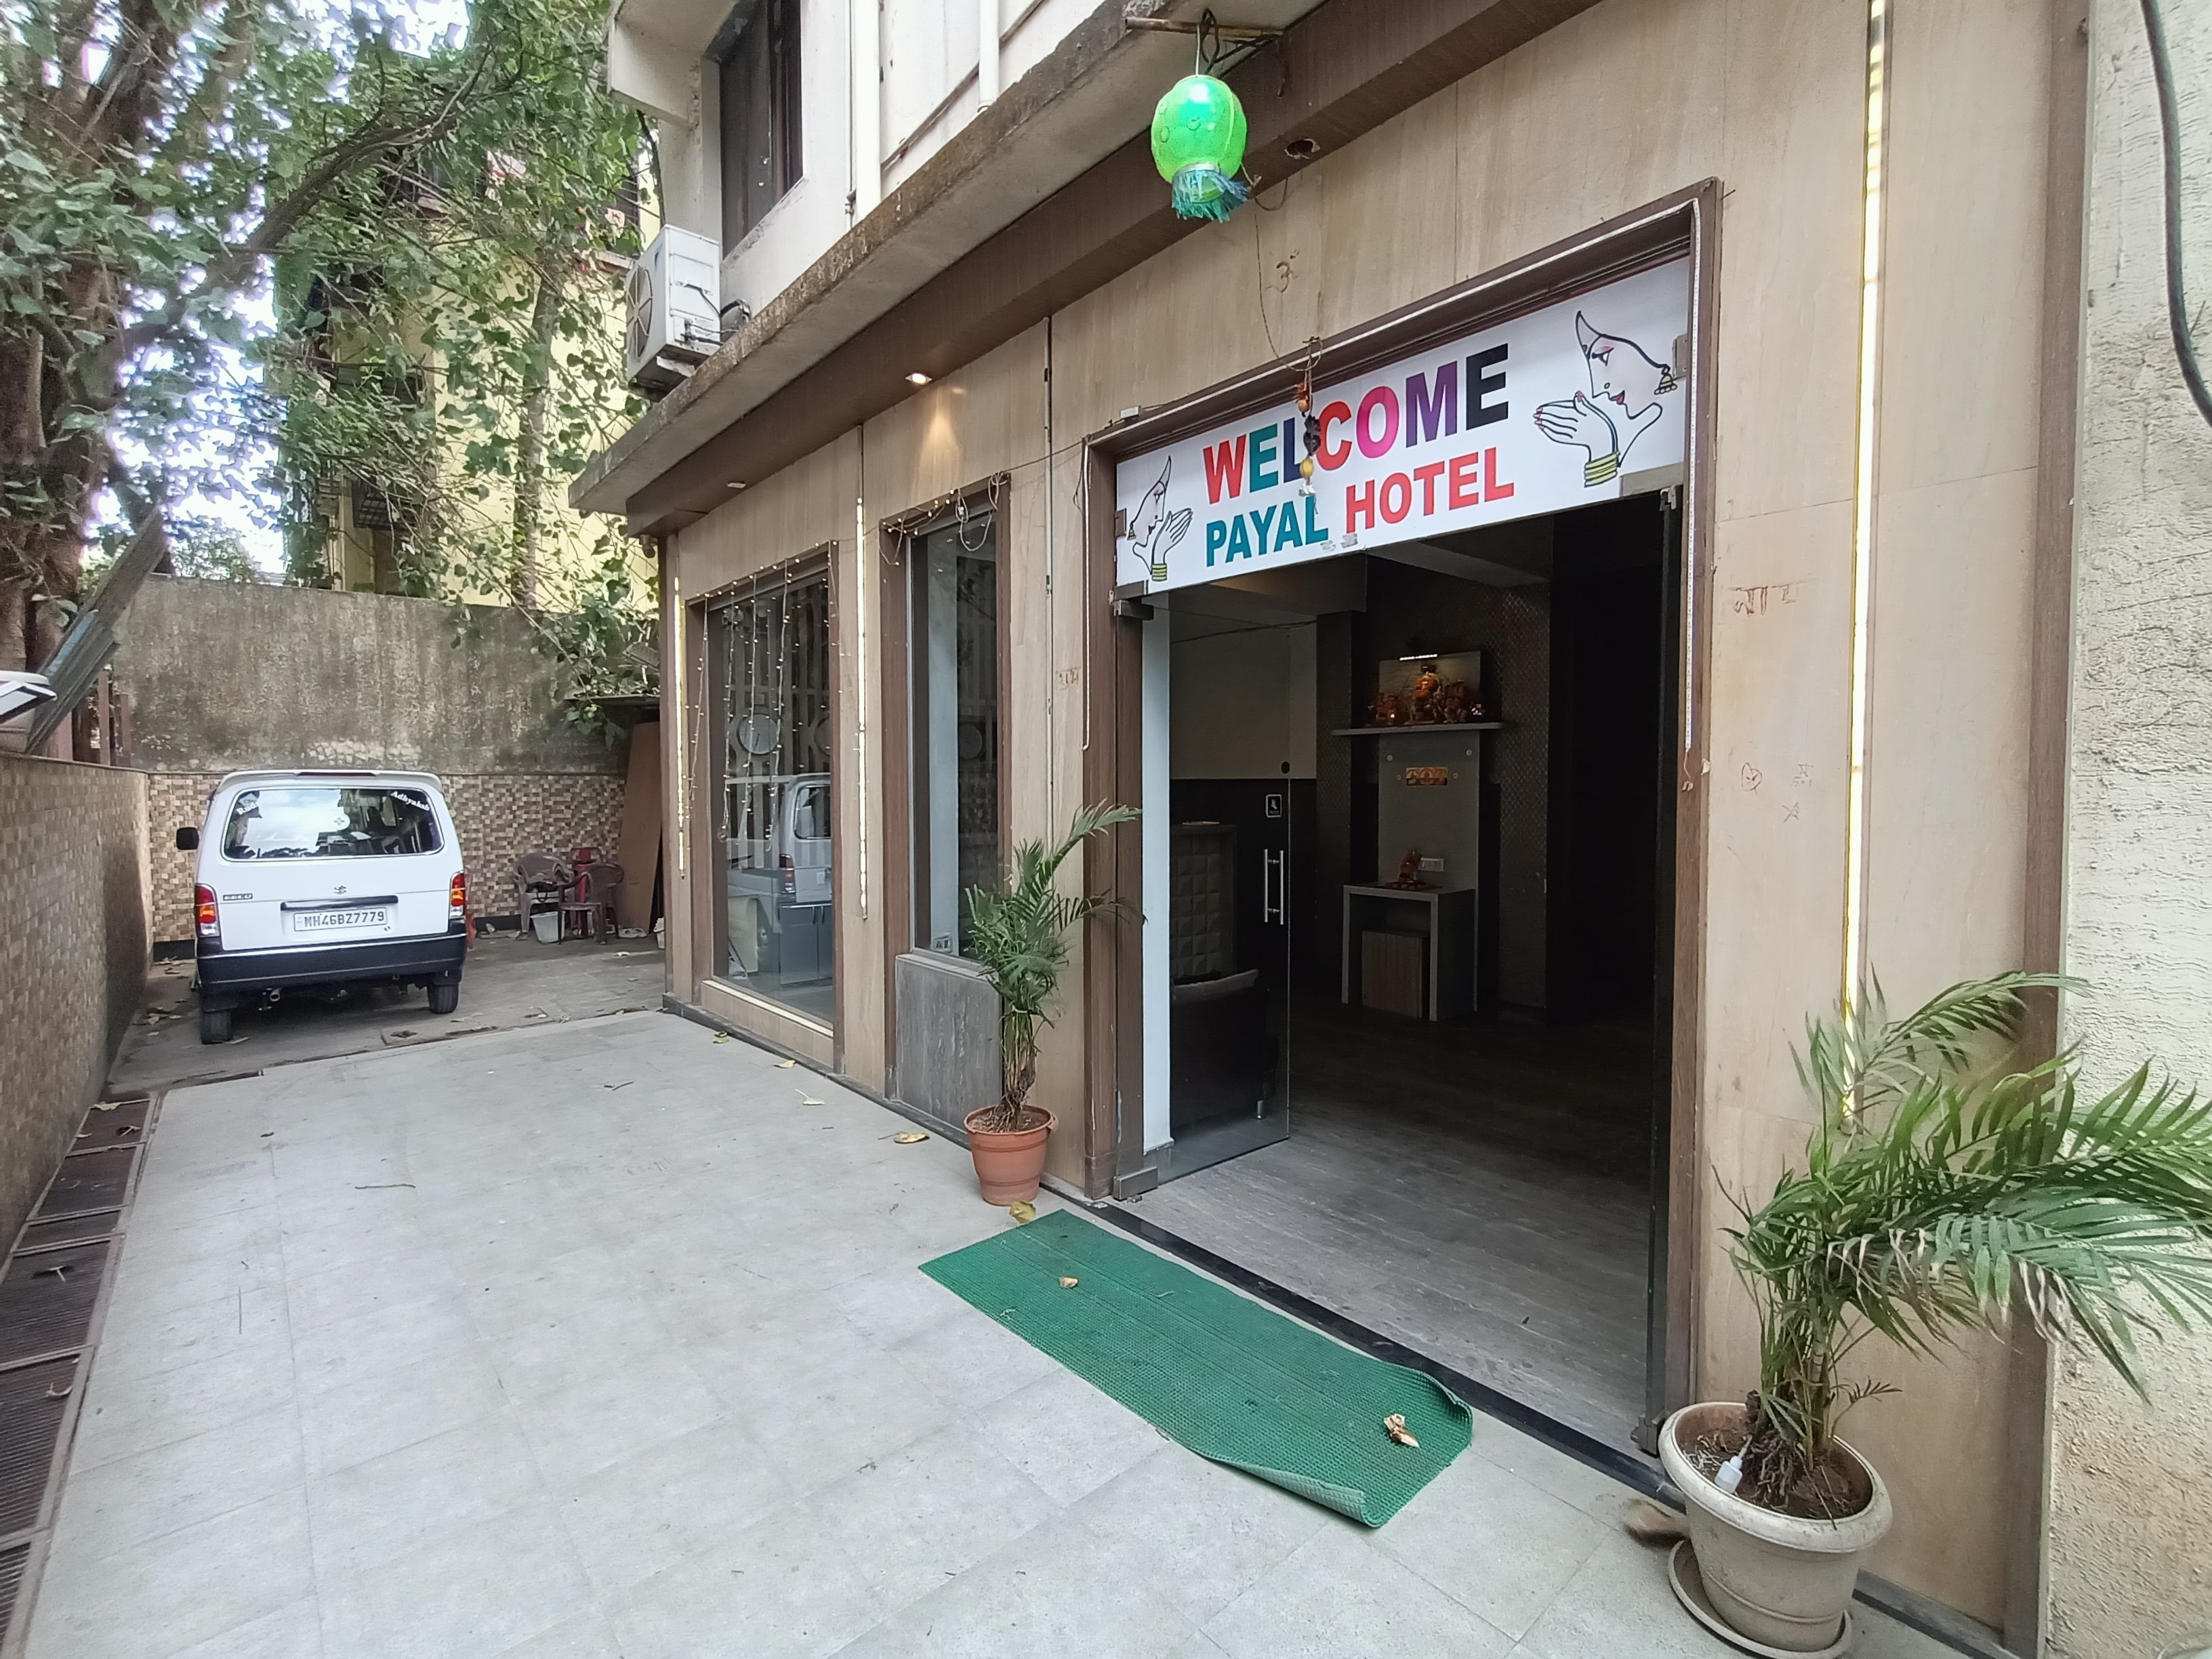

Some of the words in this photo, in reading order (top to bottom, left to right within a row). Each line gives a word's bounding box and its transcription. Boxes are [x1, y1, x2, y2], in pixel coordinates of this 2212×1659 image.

[1203, 343, 1509, 504] WELCOME
[1206, 495, 1329, 567] PAYAL
[1346, 447, 1515, 534] HOTEL
[304, 911, 385, 927] MH46BZ7779
